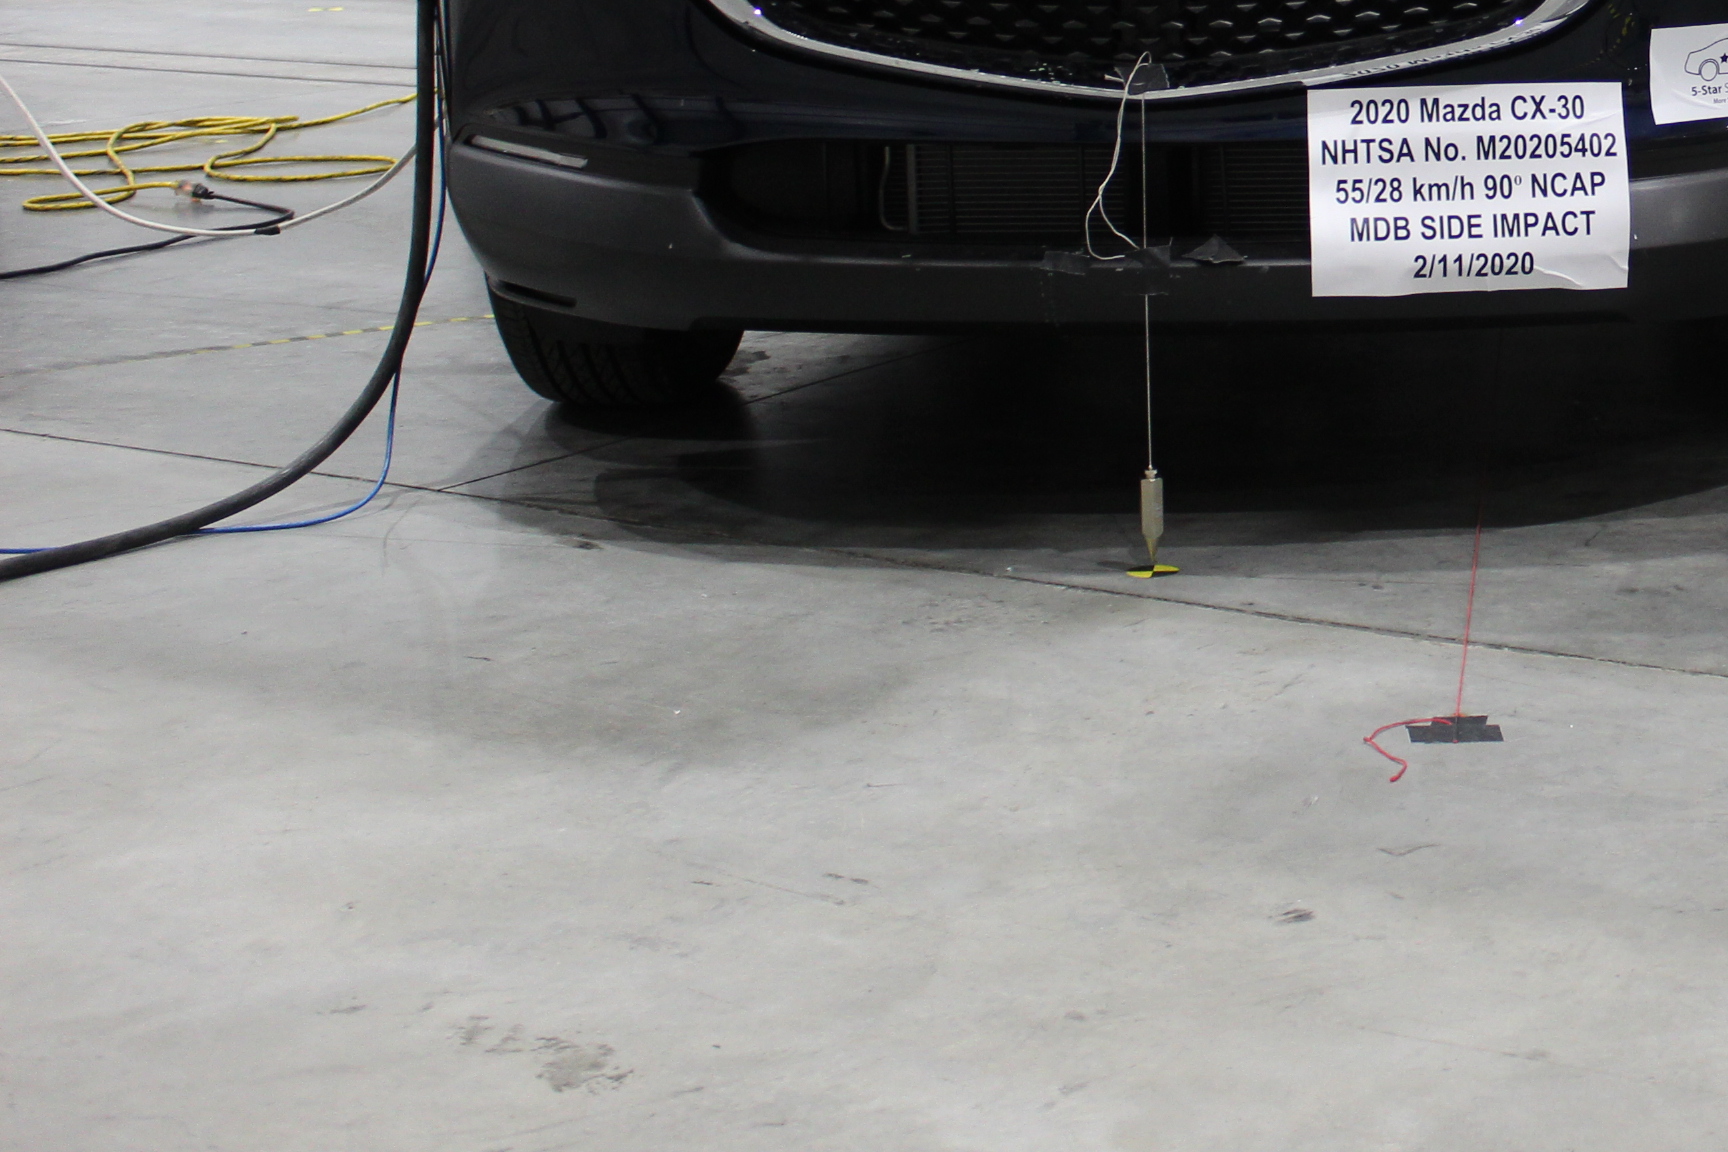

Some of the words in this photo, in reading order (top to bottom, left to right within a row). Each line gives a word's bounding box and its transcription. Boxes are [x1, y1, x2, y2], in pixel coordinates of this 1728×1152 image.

[1692, 85, 1722, 96] 5-Star
[1350, 99, 1410, 125] 2020
[1420, 97, 1502, 122] Mazda
[1511, 95, 1585, 120] CX-30
[1321, 138, 1414, 165] NHTSA
[1424, 136, 1467, 162] No.
[1476, 133, 1618, 160] M20205402
[1335, 177, 1403, 204] 55/28
[1412, 176, 1474, 201] km/h
[1531, 171, 1606, 197] NCAP
[1350, 216, 1411, 242] MDB
[1420, 214, 1483, 240] SIDE
[1492, 210, 1596, 238] IMPACT
[1413, 251, 1534, 278] 2/11/2020
